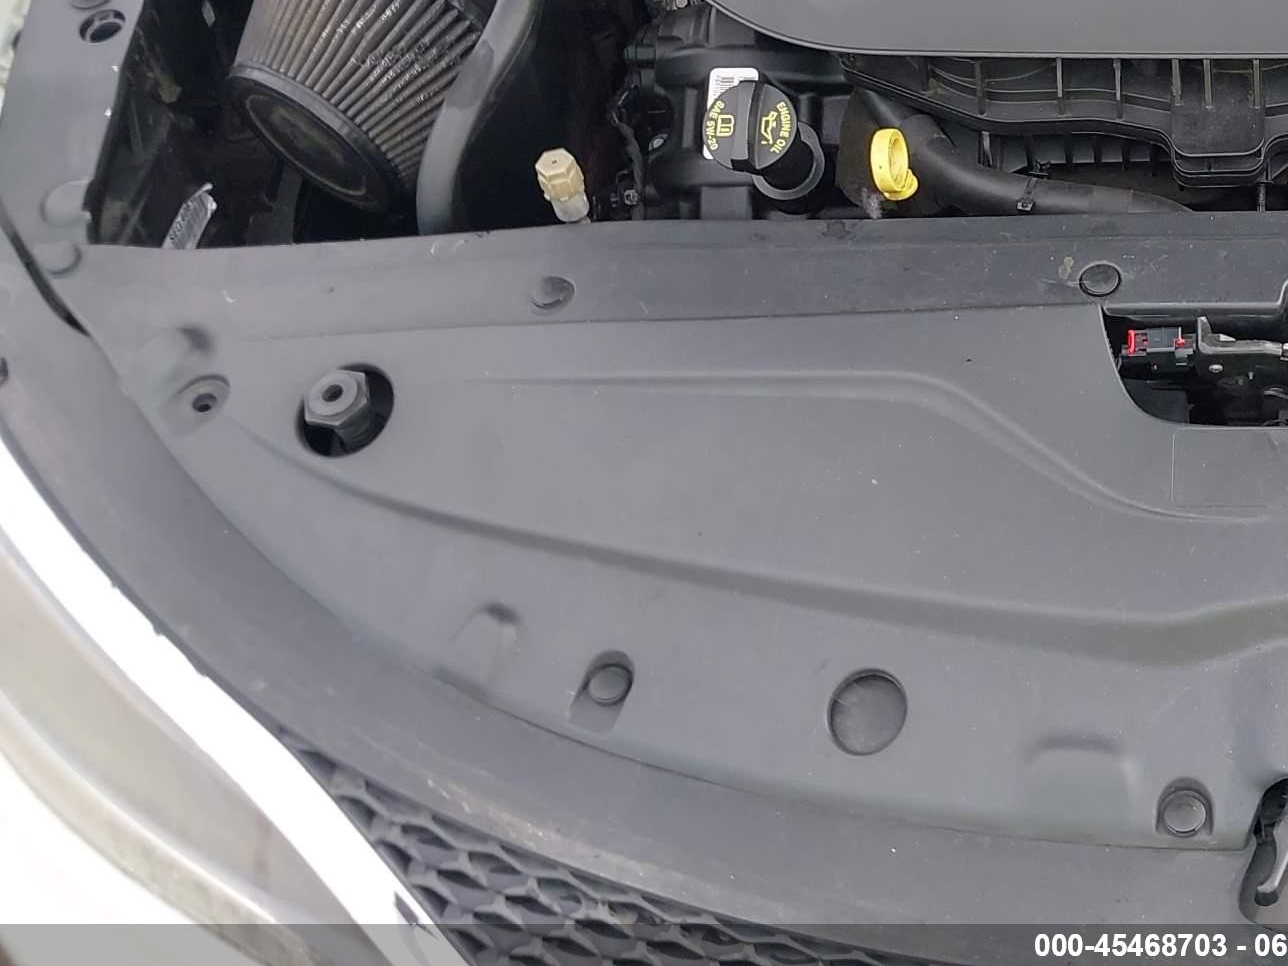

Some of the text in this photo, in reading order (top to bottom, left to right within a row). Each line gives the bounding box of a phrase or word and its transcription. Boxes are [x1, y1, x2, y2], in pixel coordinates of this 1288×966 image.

[705, 120, 719, 151] 5W-20
[769, 101, 791, 154] ENGINE OIL
